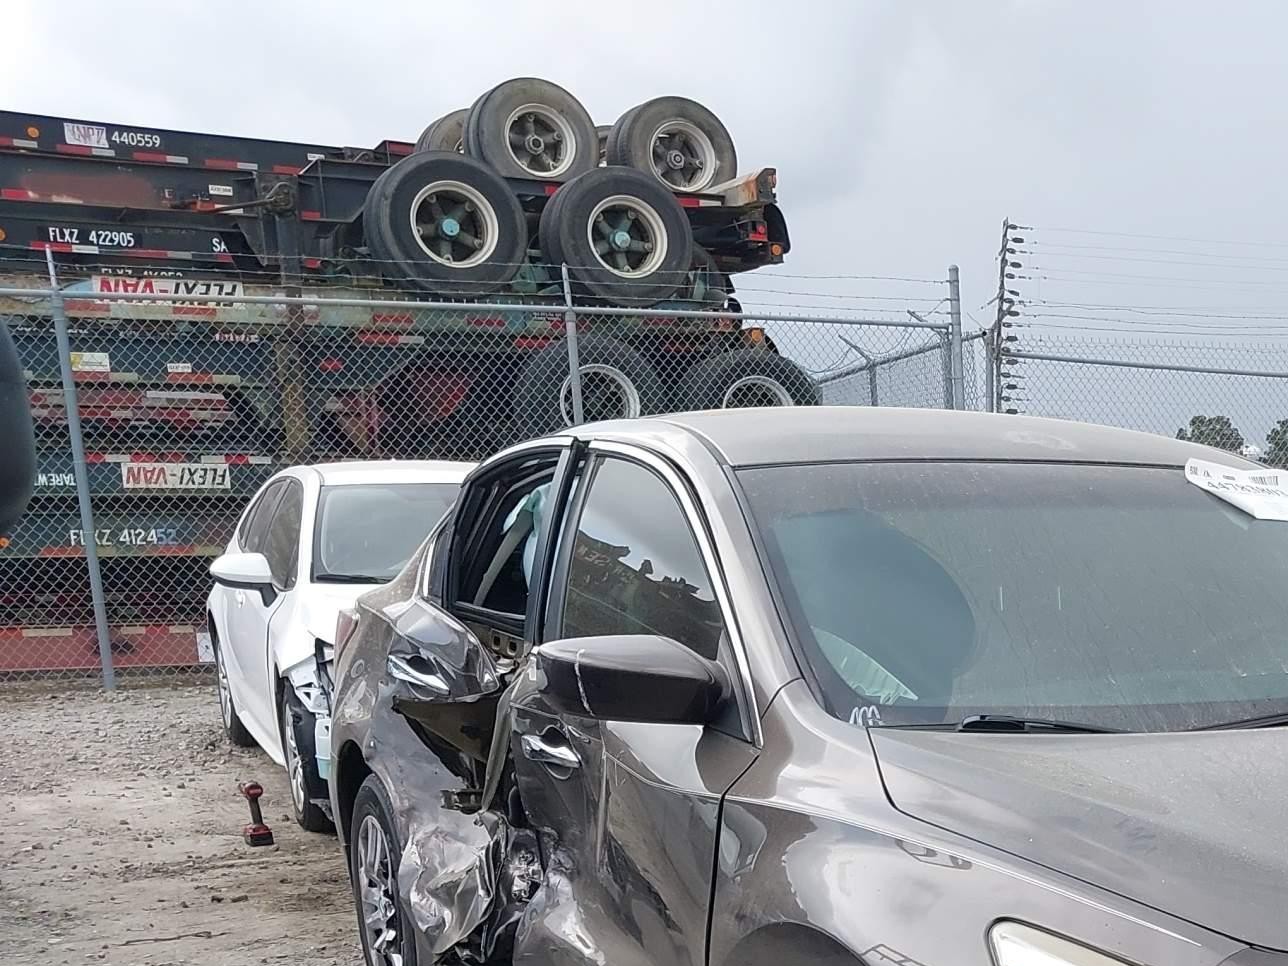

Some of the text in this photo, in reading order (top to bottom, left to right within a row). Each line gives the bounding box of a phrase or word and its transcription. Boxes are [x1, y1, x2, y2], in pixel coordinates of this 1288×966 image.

[112, 131, 160, 147] 440559
[48, 227, 135, 247] FLXZ 422905
[119, 529, 177, 545] 412452
